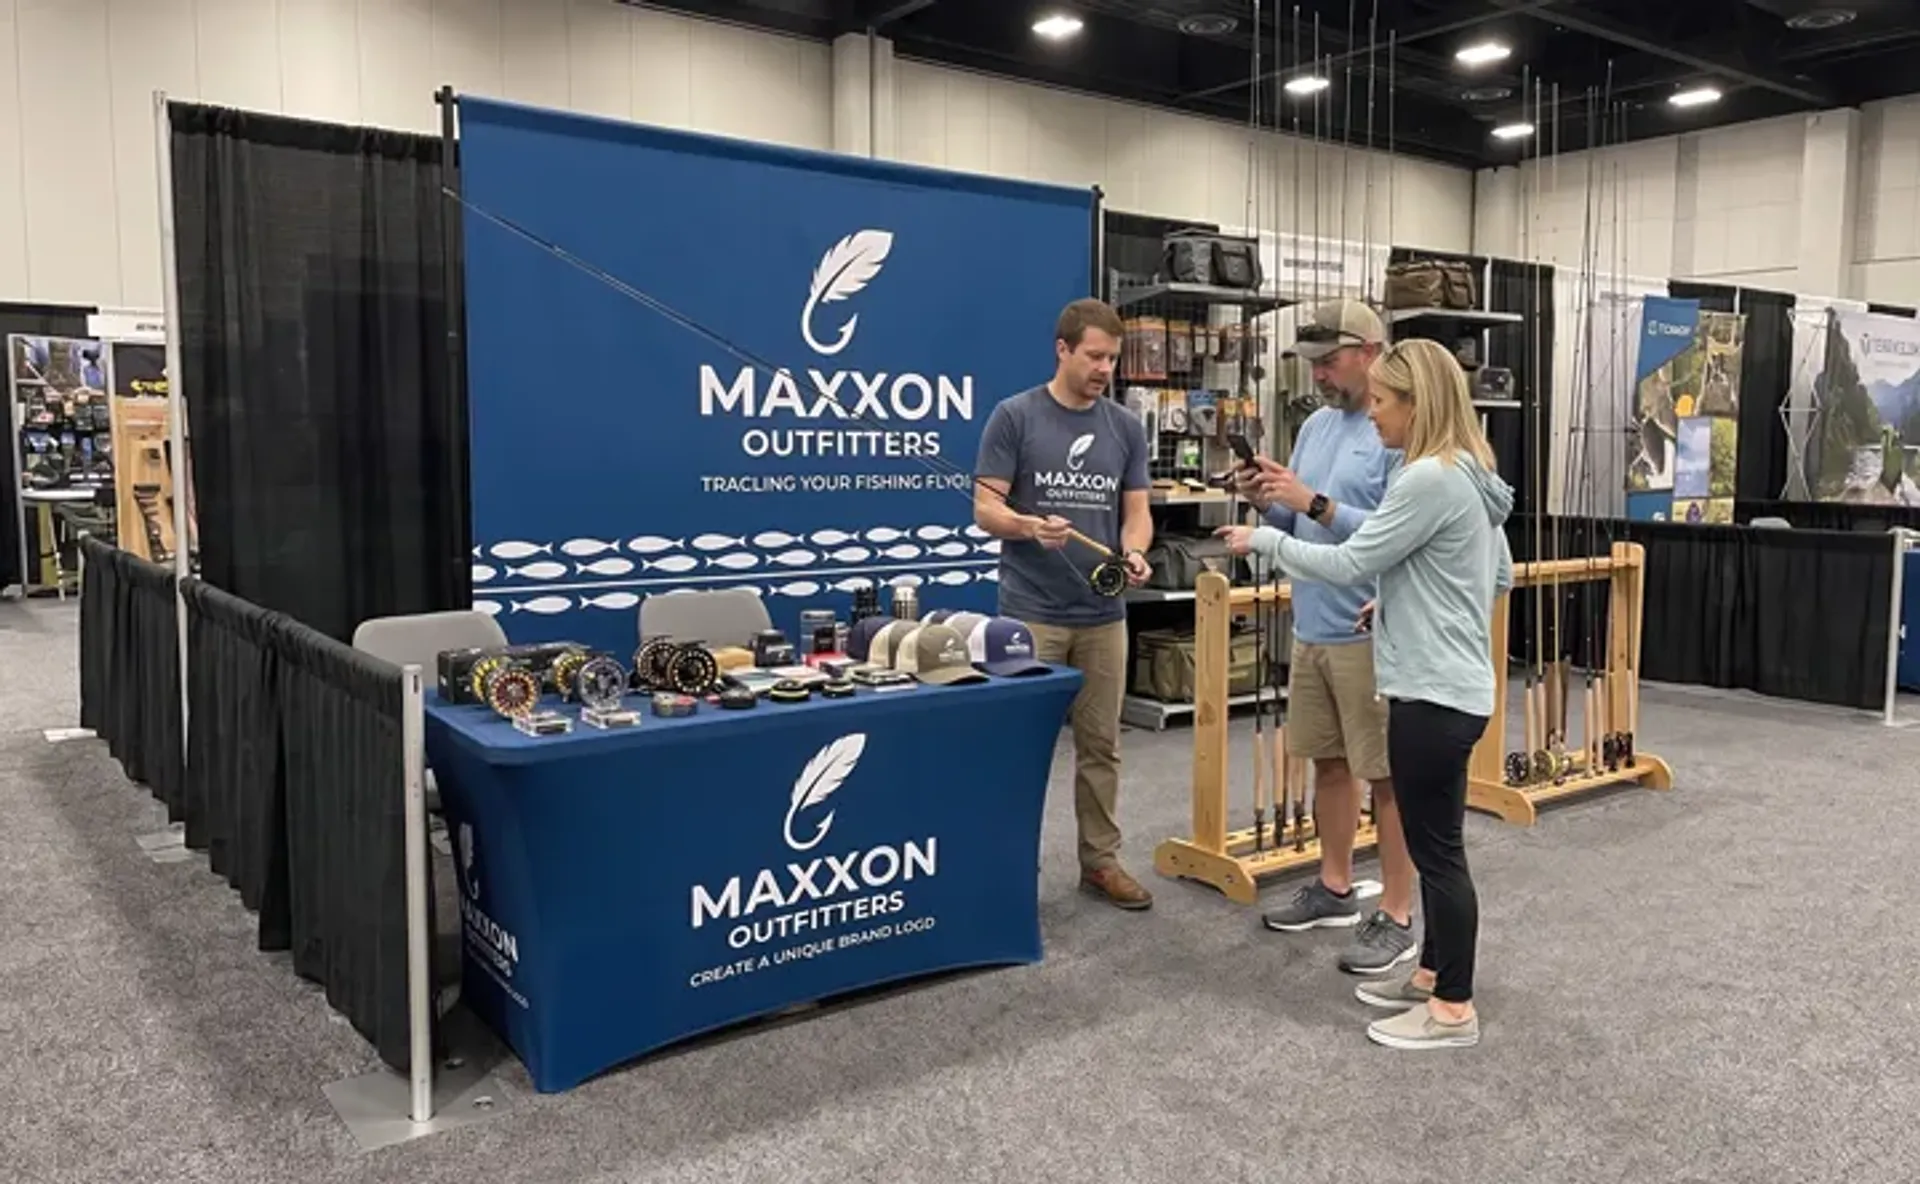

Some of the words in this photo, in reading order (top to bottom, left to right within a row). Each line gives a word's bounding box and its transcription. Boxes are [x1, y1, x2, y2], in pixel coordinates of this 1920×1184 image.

[700, 364, 973, 420] MAXXON
[742, 429, 940, 457] OUTFITTERS
[800, 475, 850, 491] YOUR
[856, 474, 922, 491] FISHING
[1035, 471, 1119, 492] MAXXON
[692, 837, 937, 929] MAXXON
[728, 891, 905, 948] OUTFITTERS
[690, 957, 754, 988] CREATE
[757, 955, 770, 969] A
[773, 938, 835, 965] UNIQUE
[838, 925, 893, 948] BRAND
